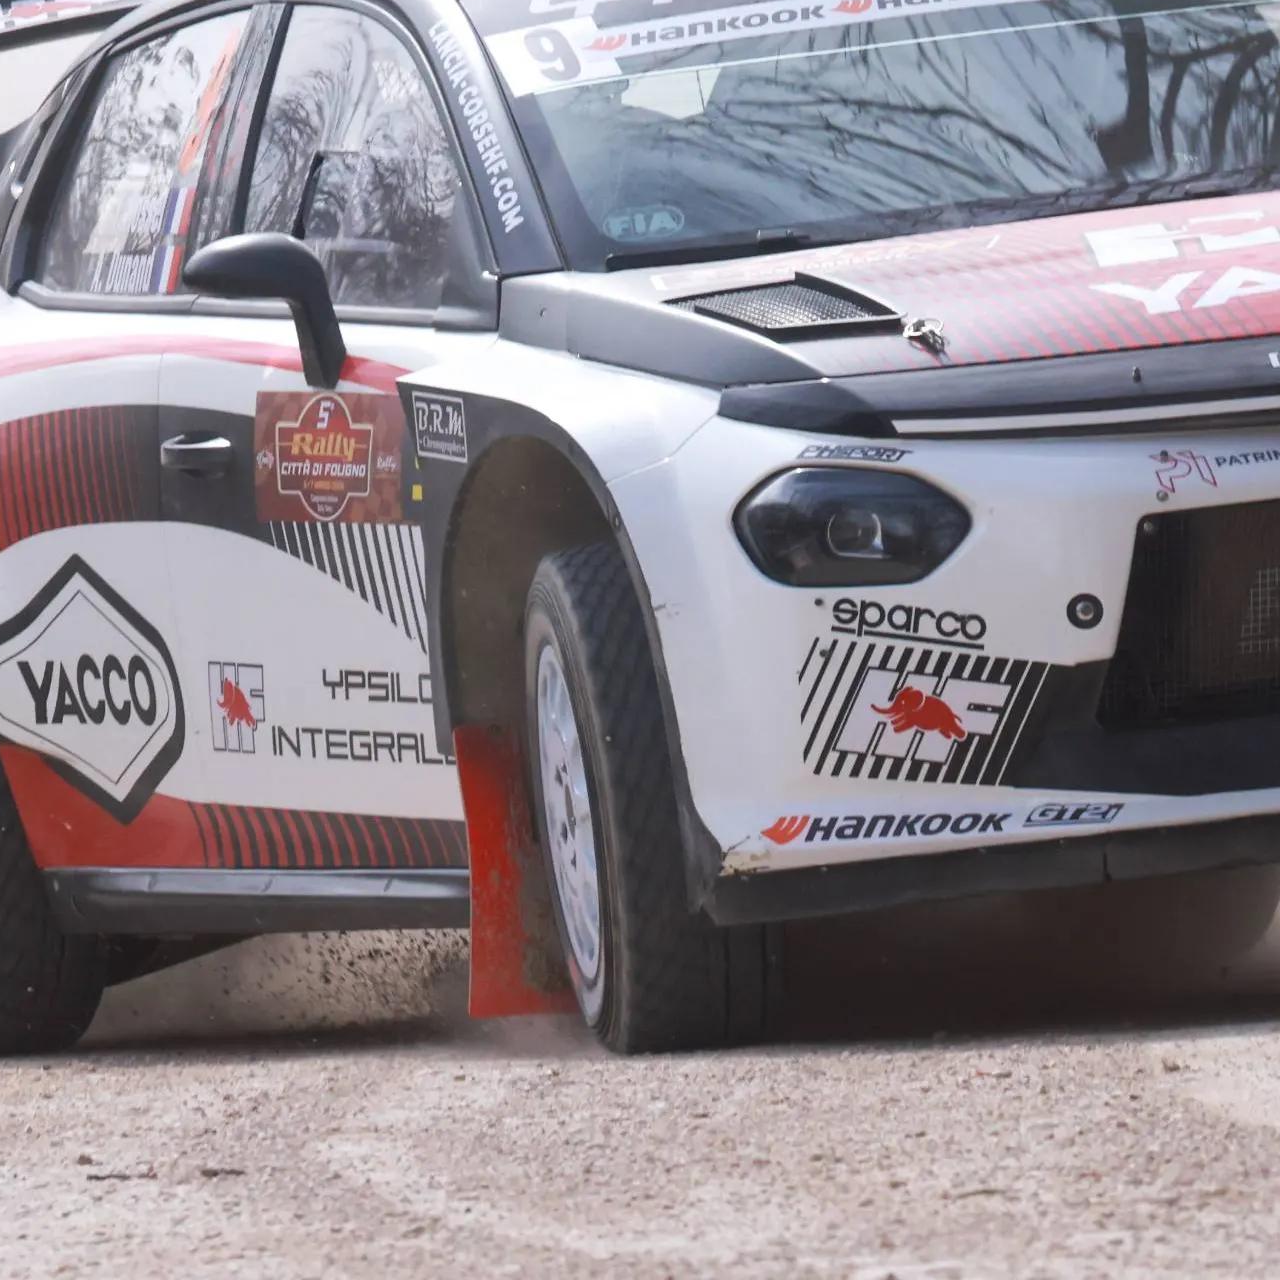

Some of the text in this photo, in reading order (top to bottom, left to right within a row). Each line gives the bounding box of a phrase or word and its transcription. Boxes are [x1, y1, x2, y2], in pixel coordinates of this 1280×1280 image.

[523, 27, 582, 82] 9
[606, 210, 678, 240] FIA
[290, 432, 356, 463] Rally
[312, 463, 323, 476] DI
[324, 463, 366, 478] FOLIGNO
[832, 597, 987, 642] sparco
[17, 654, 157, 726] YACCO
[322, 669, 433, 705] YPSILO
[271, 724, 457, 766] INTEGRAL
